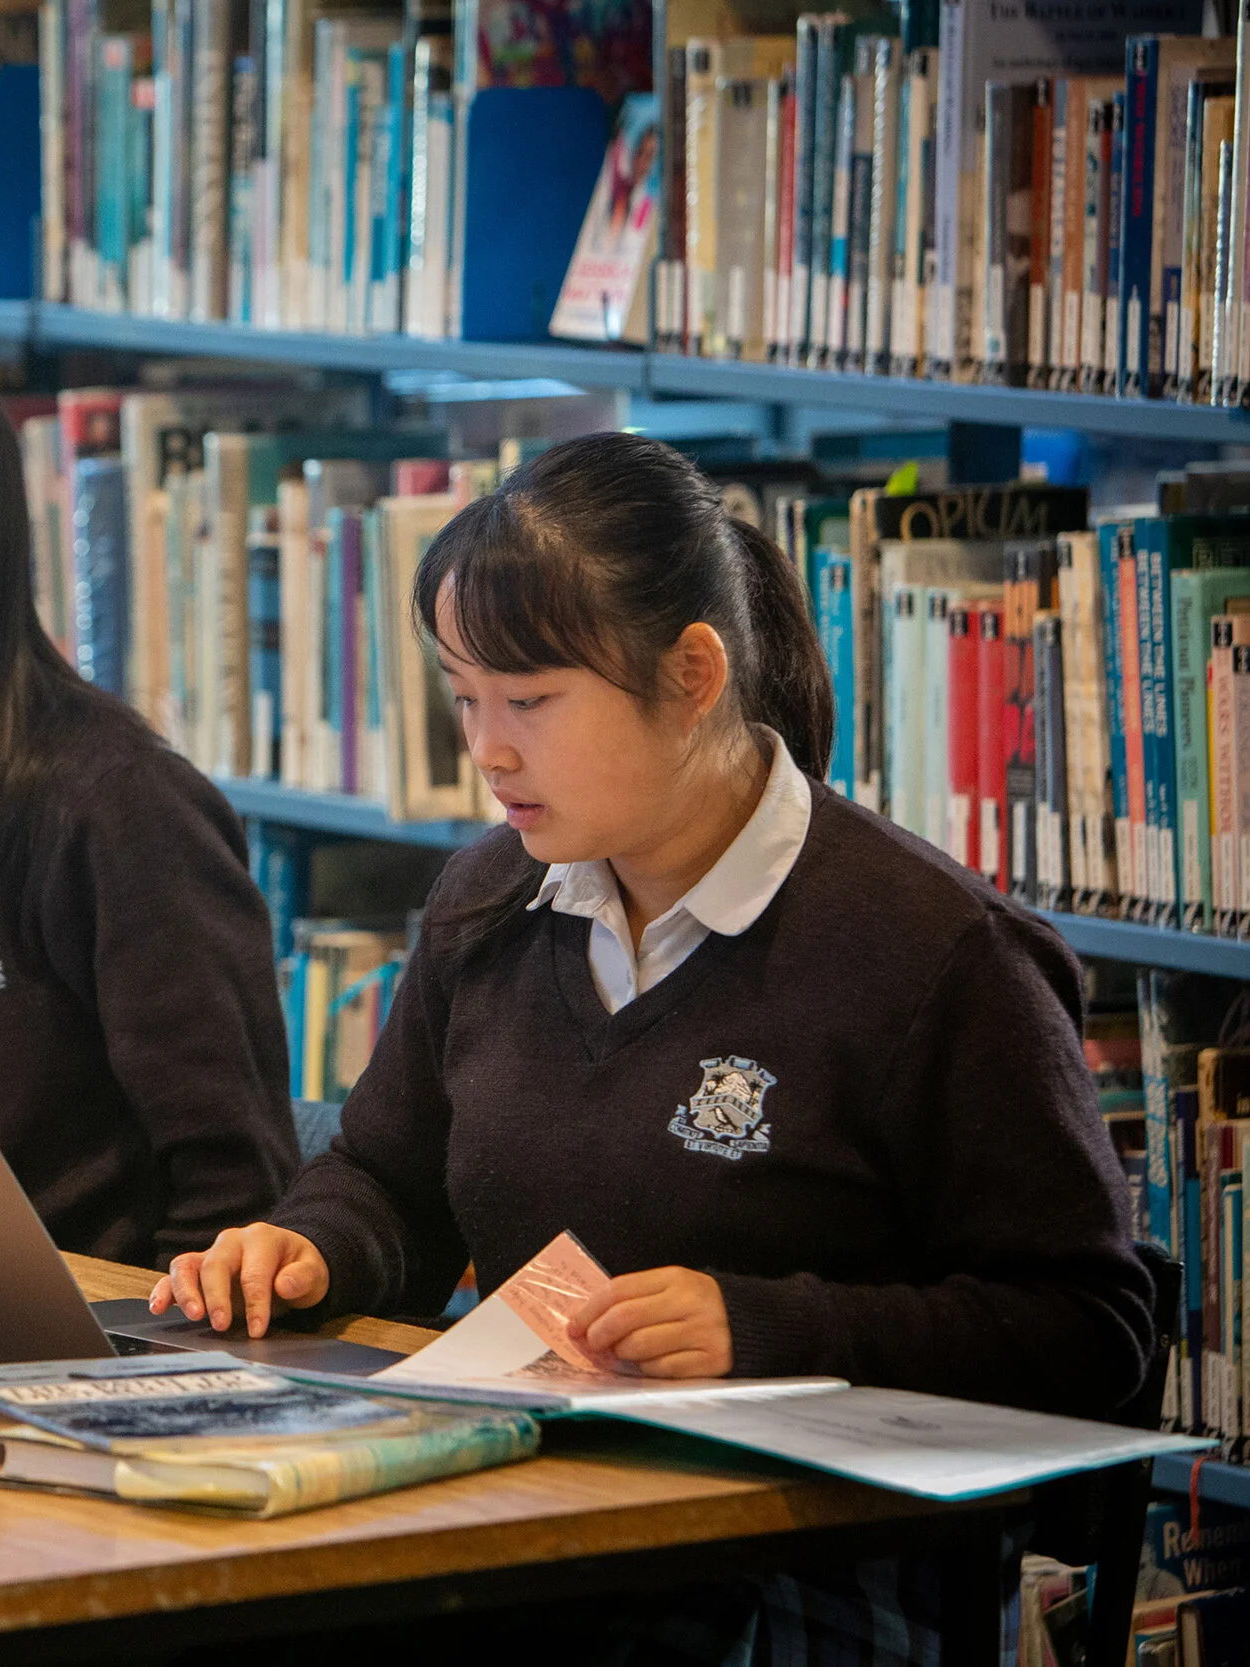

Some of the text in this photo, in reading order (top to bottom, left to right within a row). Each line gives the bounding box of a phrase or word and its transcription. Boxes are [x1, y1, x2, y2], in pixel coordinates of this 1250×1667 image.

[901, 486, 1048, 540] OPIUM
[1136, 549, 1155, 734] BETWEEN THE LINES
[1150, 552, 1167, 737] BETWEEN THE LINES
[1162, 1516, 1250, 1561] Remem
[1182, 1557, 1243, 1589] When
